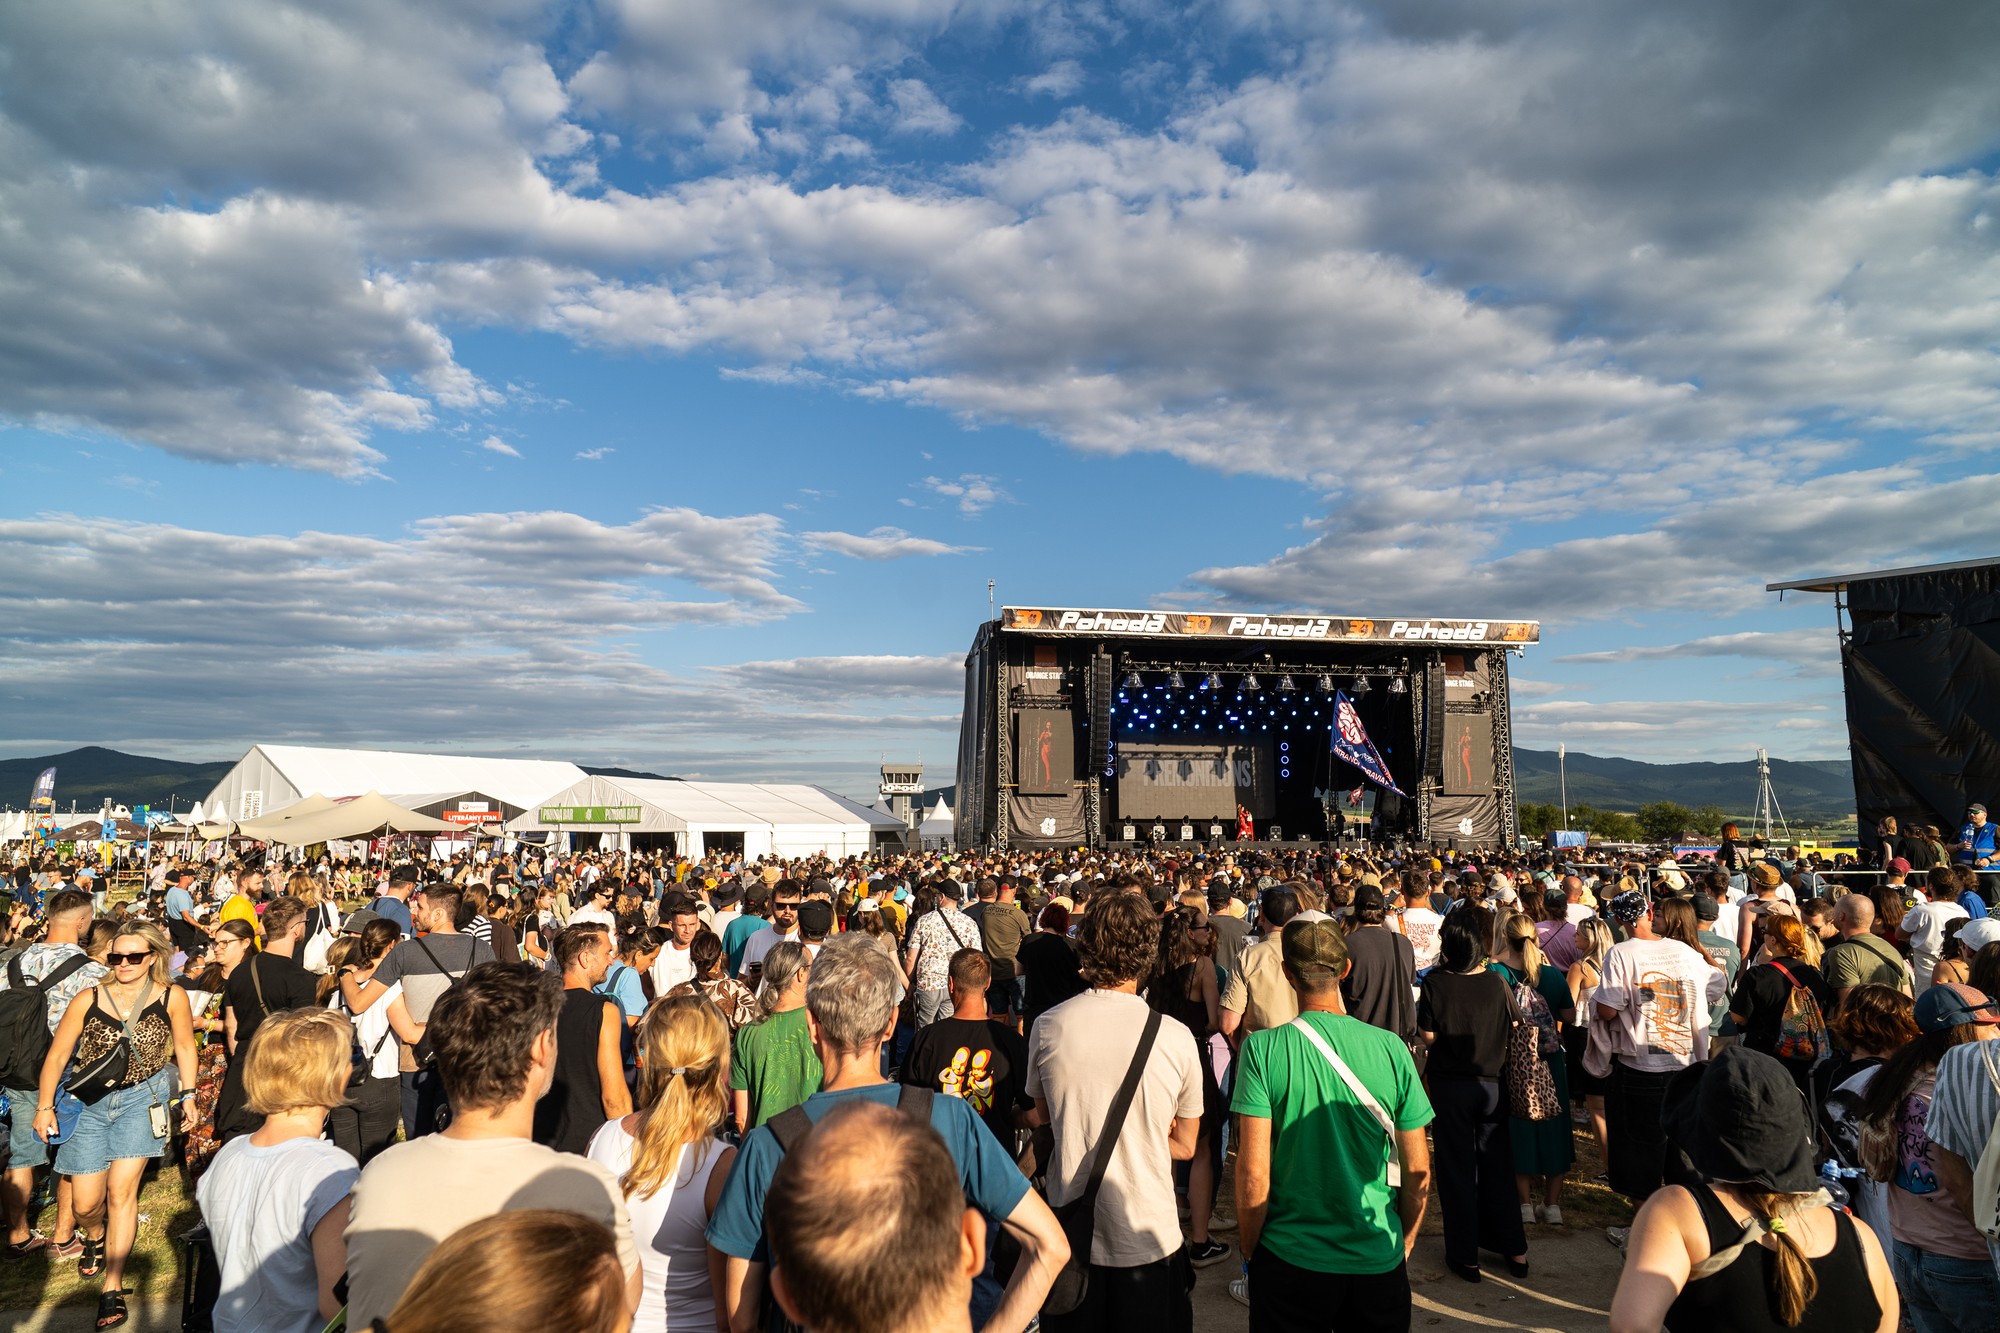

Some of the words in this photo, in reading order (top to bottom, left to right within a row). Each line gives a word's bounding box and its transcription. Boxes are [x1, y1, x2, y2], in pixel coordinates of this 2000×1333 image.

[1058, 611, 1167, 633] Pohoda
[1227, 617, 1331, 637] Pohoda
[1389, 621, 1488, 640] Pohoda
[1025, 671, 1048, 680] ORANGE
